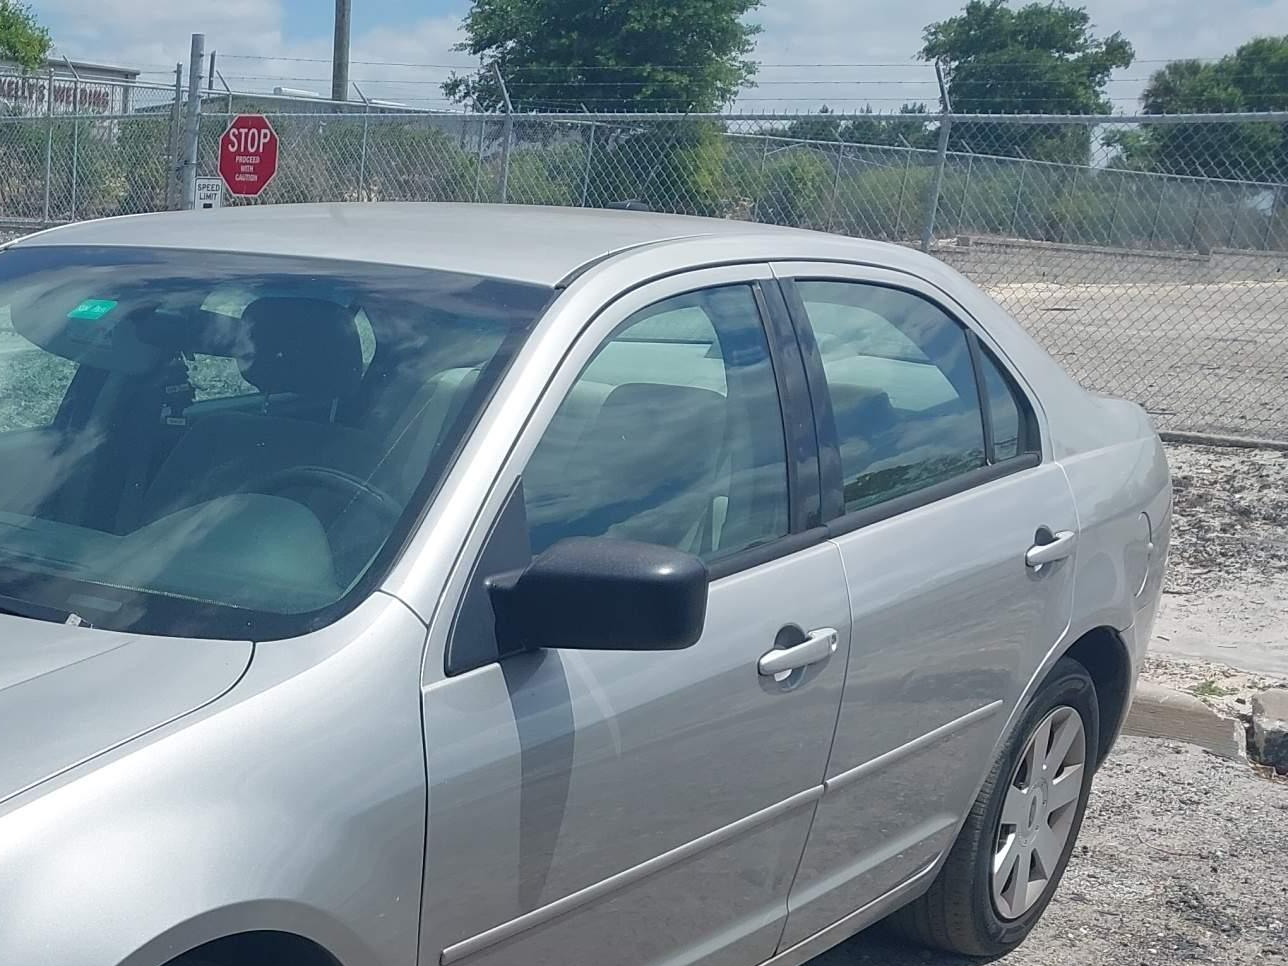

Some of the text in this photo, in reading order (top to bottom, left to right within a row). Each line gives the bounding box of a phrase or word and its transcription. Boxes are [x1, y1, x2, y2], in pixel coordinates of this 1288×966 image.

[228, 128, 270, 152] STOP
[235, 155, 260, 163] PROCEED
[240, 165, 254, 173] WITH
[234, 174, 258, 182] CAUTION
[197, 183, 220, 192] SPEED
[199, 193, 217, 201] LIMIT
